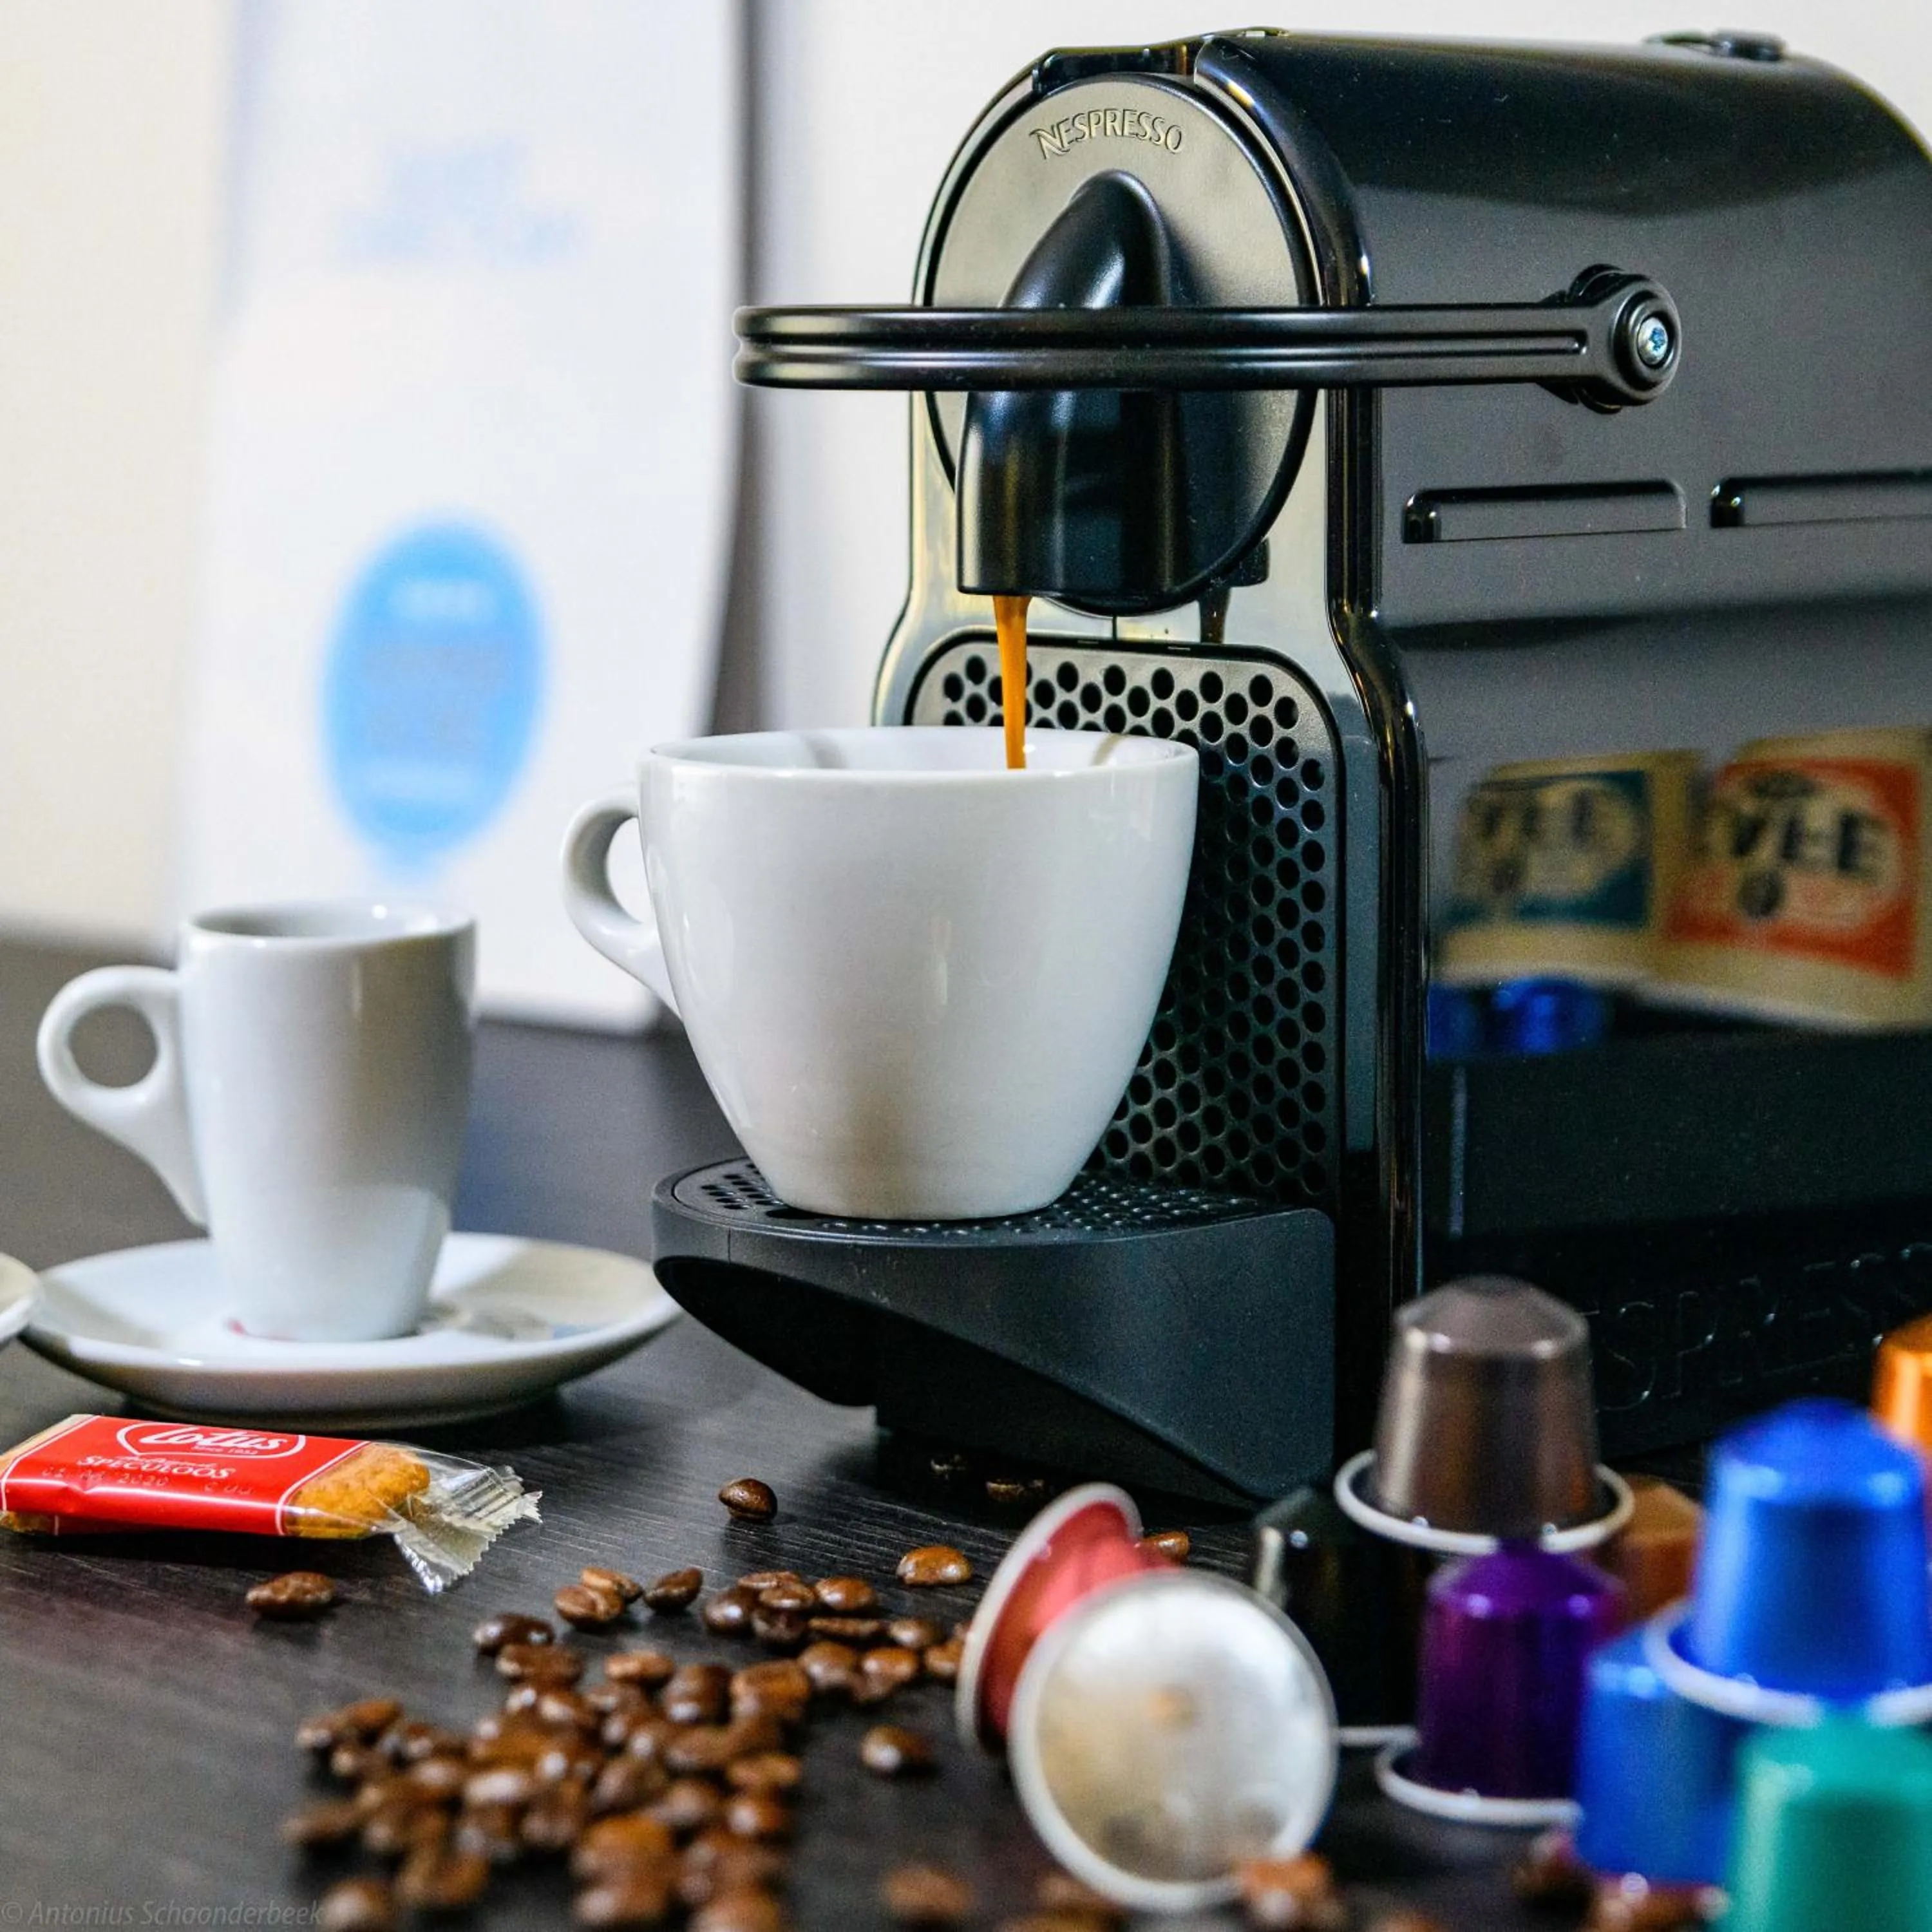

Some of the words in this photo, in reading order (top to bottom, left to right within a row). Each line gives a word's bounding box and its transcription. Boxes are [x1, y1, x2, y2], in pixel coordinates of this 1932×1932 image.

[1029, 108, 1184, 160] NESPRESSO
[139, 1426, 287, 1450] Lotus
[77, 1455, 236, 1479] SPECULOOS
